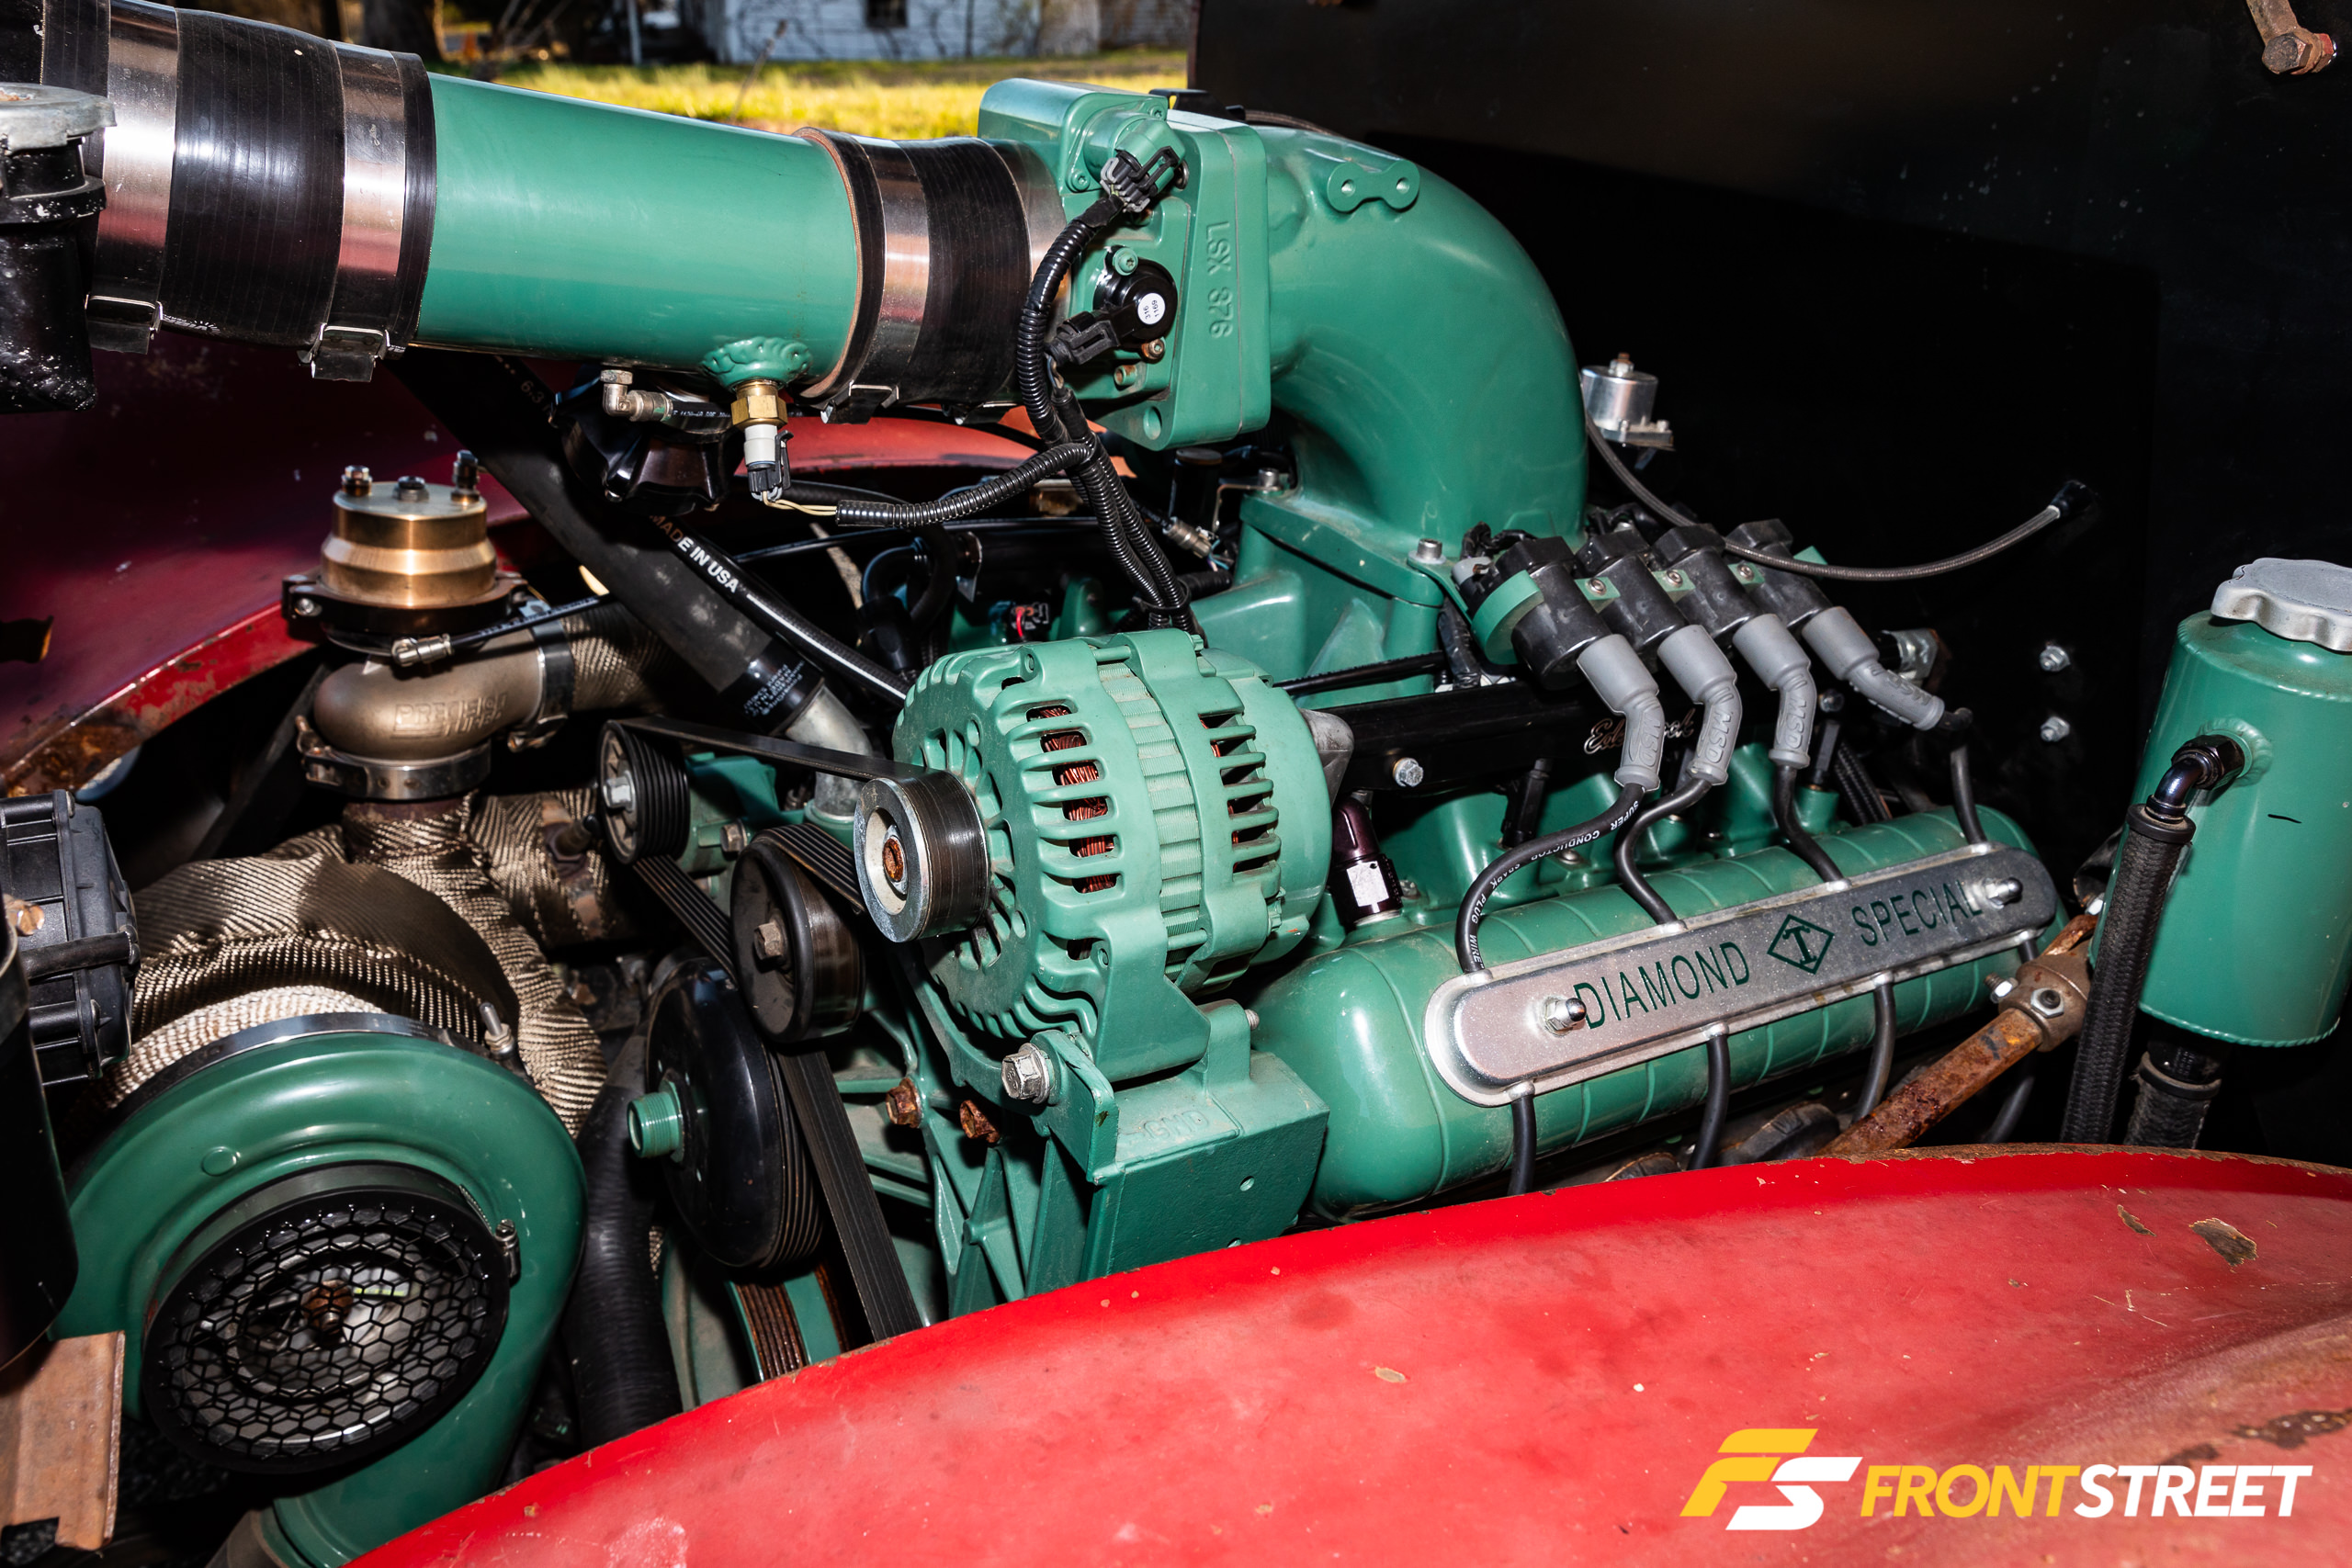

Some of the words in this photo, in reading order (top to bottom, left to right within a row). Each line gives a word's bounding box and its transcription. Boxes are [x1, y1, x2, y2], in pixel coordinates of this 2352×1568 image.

[1205, 220, 1231, 276] LSX
[648, 515, 695, 552] MADE
[689, 546, 711, 567] IN
[707, 560, 740, 593] USA
[1639, 712, 1662, 768] MSD
[1705, 710, 1732, 764] MSD
[1784, 696, 1807, 750] MSD
[1610, 800, 1639, 831] SUPER
[1471, 893, 1487, 924] PLUG
[1573, 942, 1750, 1030] DIAMOND
[1851, 879, 1983, 947] SPECIAL
